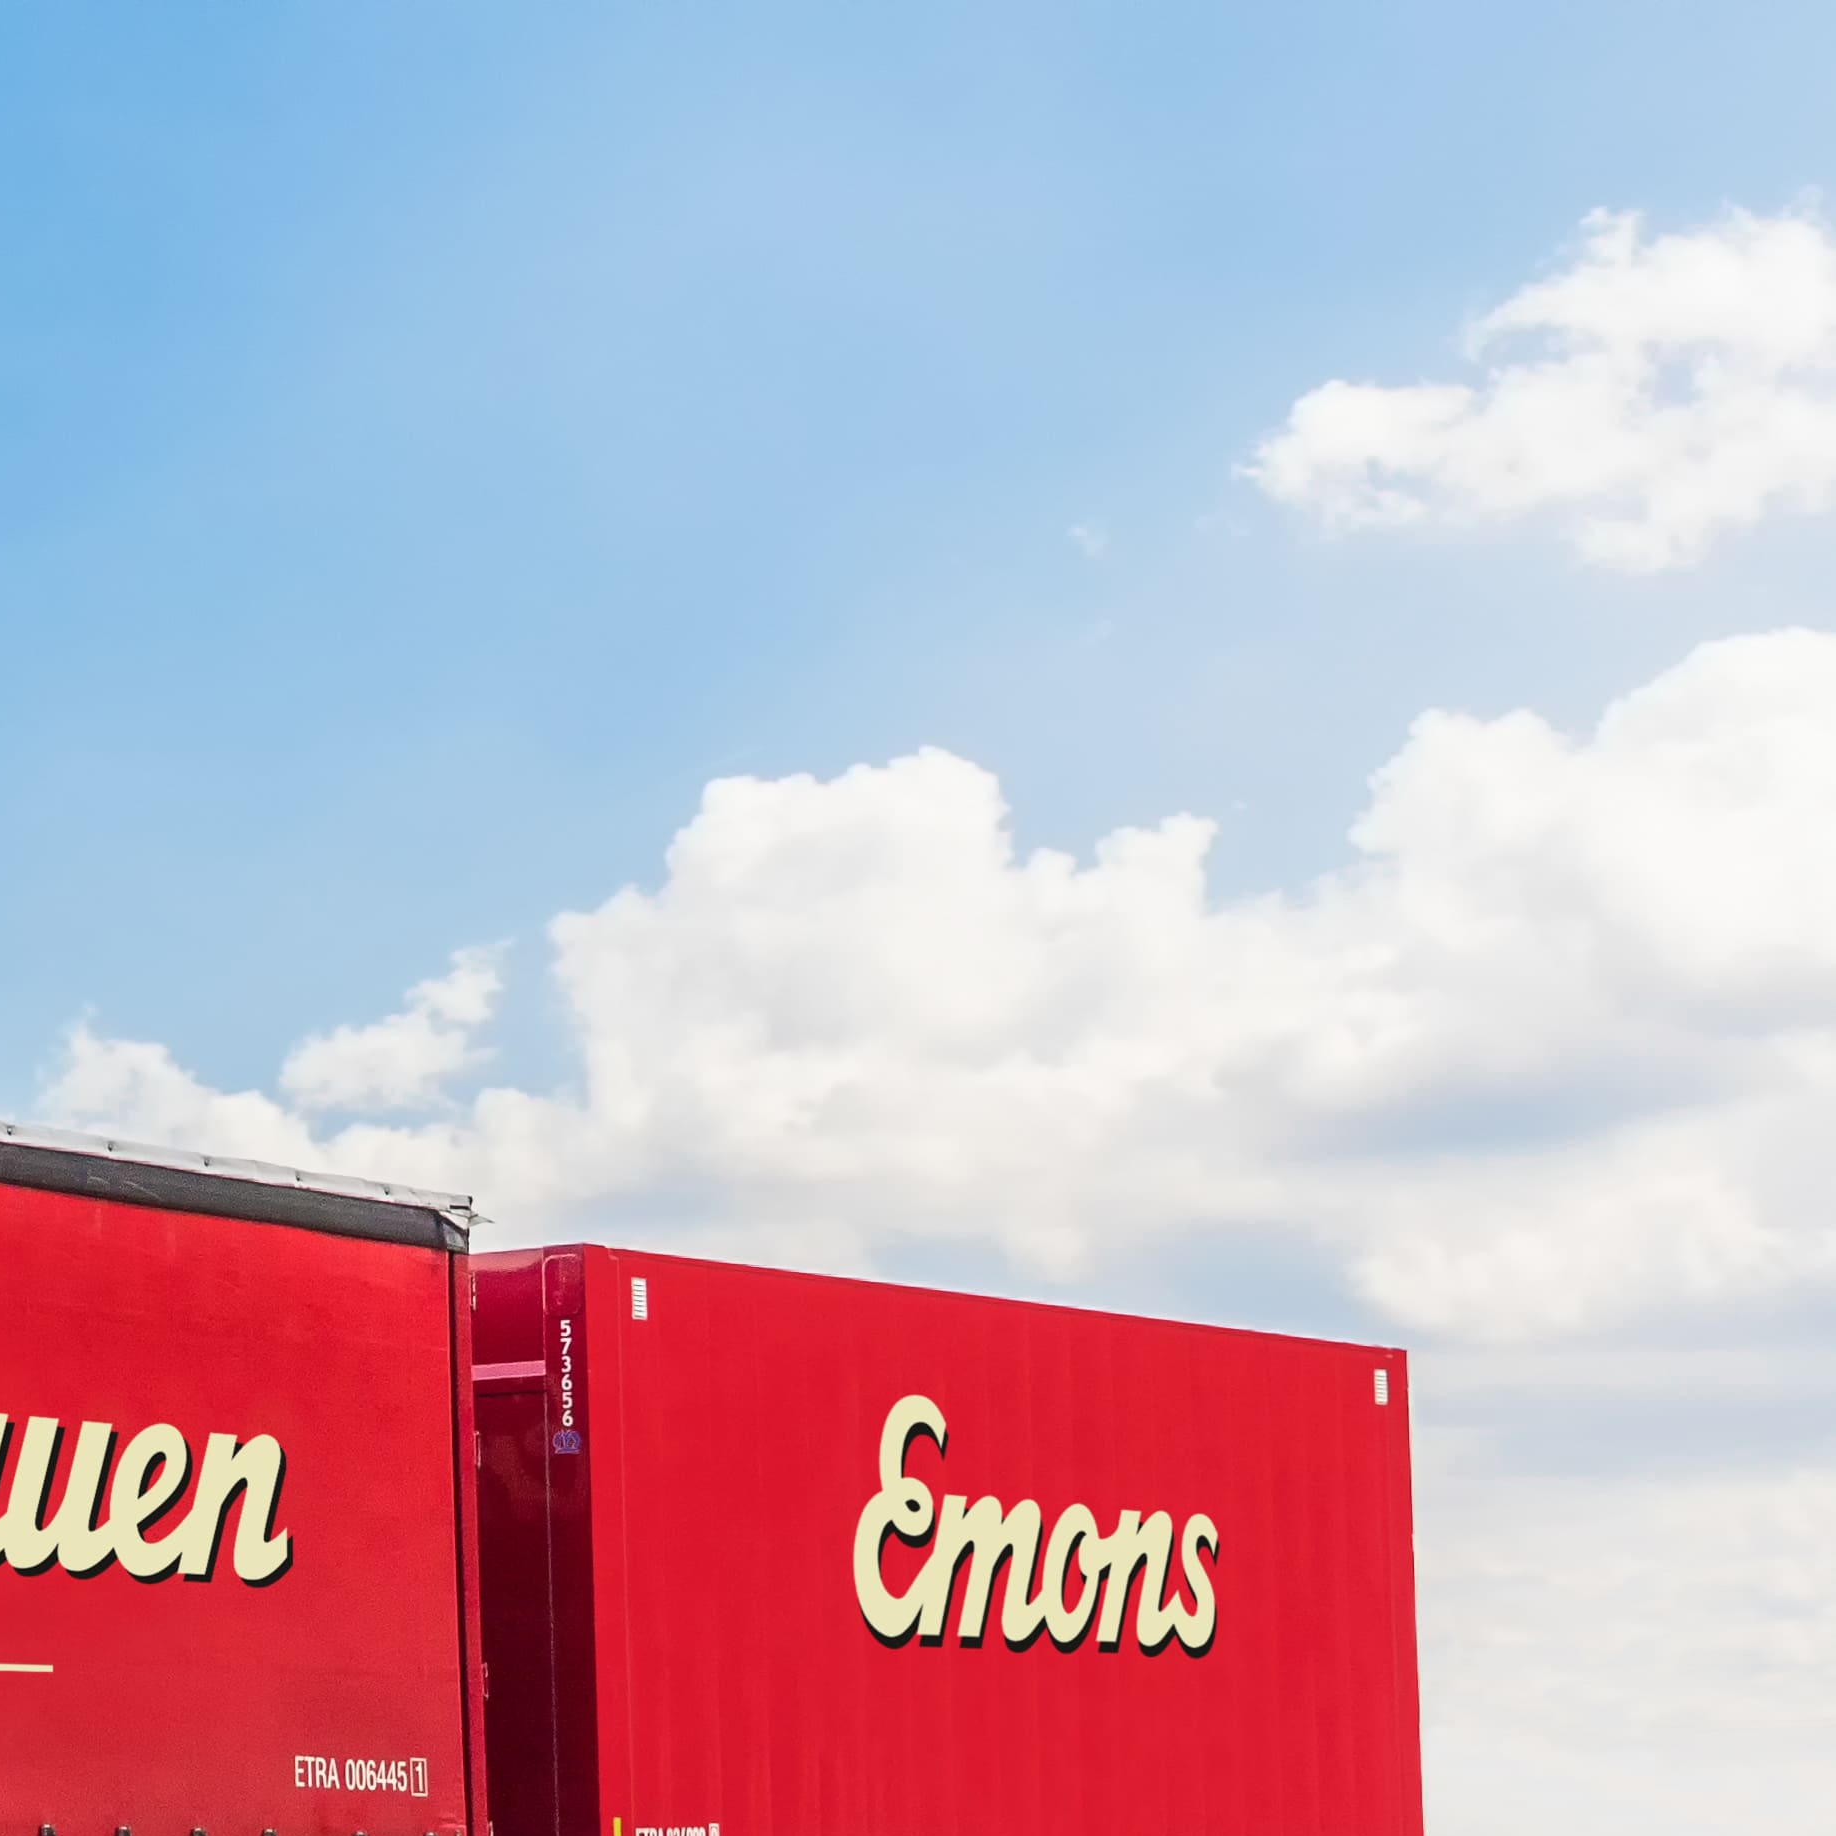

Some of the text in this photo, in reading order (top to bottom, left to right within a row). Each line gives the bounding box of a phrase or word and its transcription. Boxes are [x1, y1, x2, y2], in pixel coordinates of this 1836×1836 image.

[559, 1319, 575, 1428] 573656
[853, 1394, 1220, 1658] Emons
[294, 1755, 341, 1790] ETRA
[345, 1758, 408, 1792] 006445
